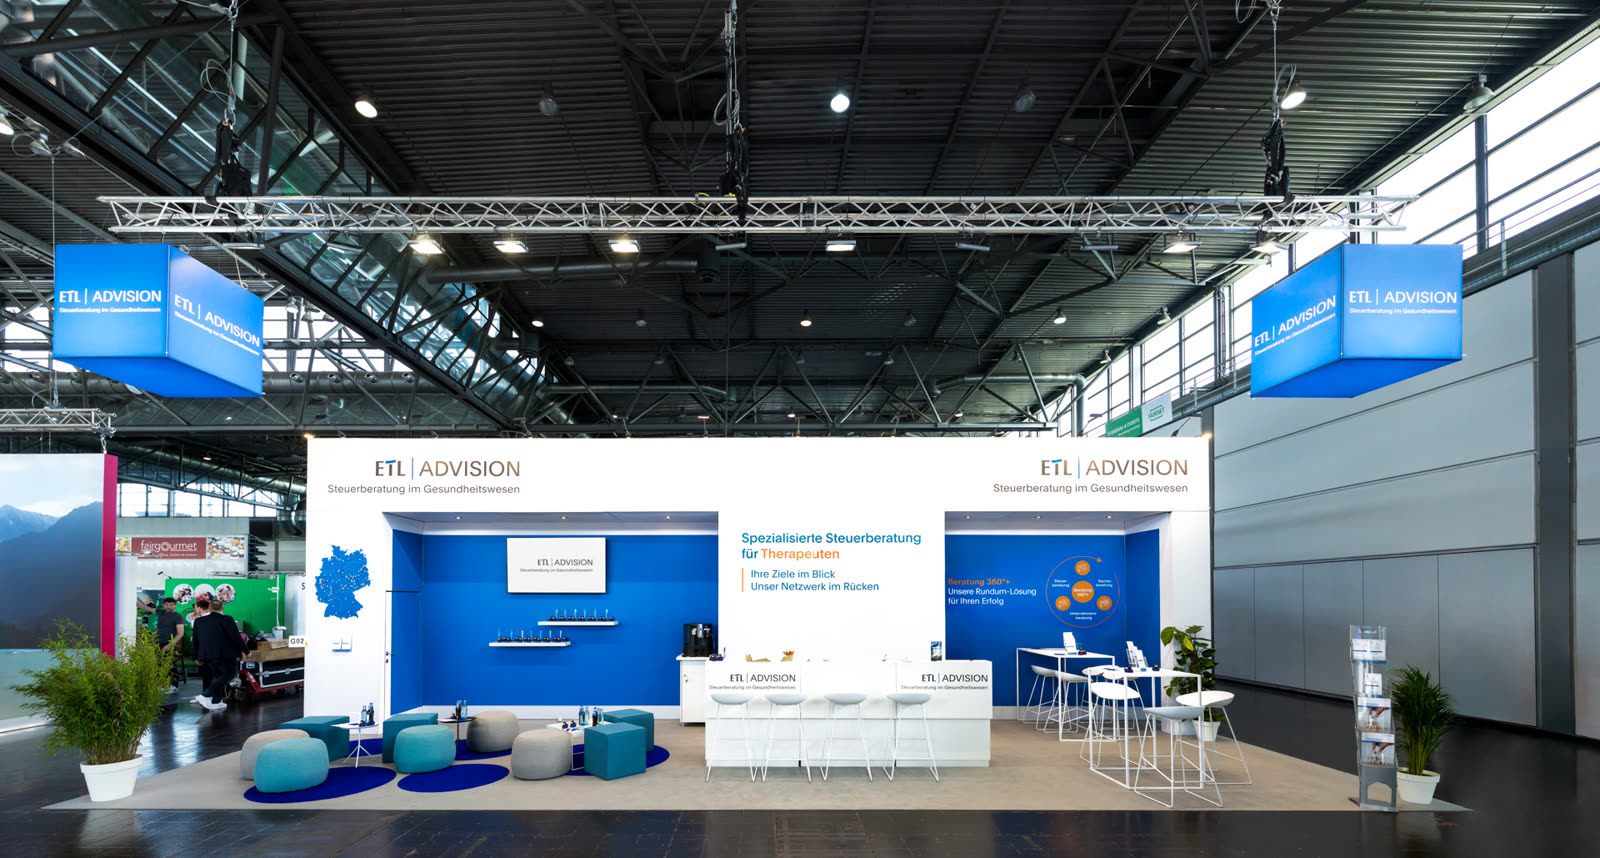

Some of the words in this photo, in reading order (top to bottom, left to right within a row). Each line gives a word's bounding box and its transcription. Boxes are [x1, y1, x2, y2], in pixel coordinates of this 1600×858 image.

[59, 290, 81, 303] ETL
[92, 290, 162, 303] ADVISION
[1349, 290, 1372, 303] ETL
[1384, 291, 1457, 304] ADVISION
[174, 294, 196, 315] ETL
[204, 311, 260, 348] ADVISION
[1254, 331, 1270, 348] ETL
[1278, 295, 1336, 336] ADVISION
[375, 460, 406, 477] ETL
[419, 460, 520, 477] ADVISION
[1041, 459, 1072, 476] ETL
[1085, 460, 1188, 476] ADVISION
[328, 484, 406, 494] Steuerberatung
[408, 484, 420, 494] im
[423, 484, 520, 494] Gesundheitswesen
[993, 484, 1072, 494] Steuerberatung
[1075, 484, 1088, 492] im
[1090, 484, 1188, 492] Gesundheitswesen
[742, 532, 823, 545] Spezialisierte
[826, 532, 922, 546] Steuerberatung
[742, 548, 758, 559] für
[761, 548, 840, 560] Therapeuten
[751, 570, 770, 578] Ihre
[772, 570, 796, 578] Ziele
[798, 570, 810, 578] im
[812, 570, 836, 578] Blick
[751, 582, 778, 591] Unser
[781, 582, 826, 591] Netzwerk
[828, 582, 841, 591] im
[843, 582, 880, 591] Rücken
[948, 578, 984, 586] Beratung
[976, 588, 1037, 596] Rundum-Lösung
[982, 598, 1004, 606] Erfolg
[730, 674, 745, 682] ETL
[750, 674, 796, 682] ADVISION
[922, 674, 936, 682] ETL
[942, 674, 988, 682] ADVISION
